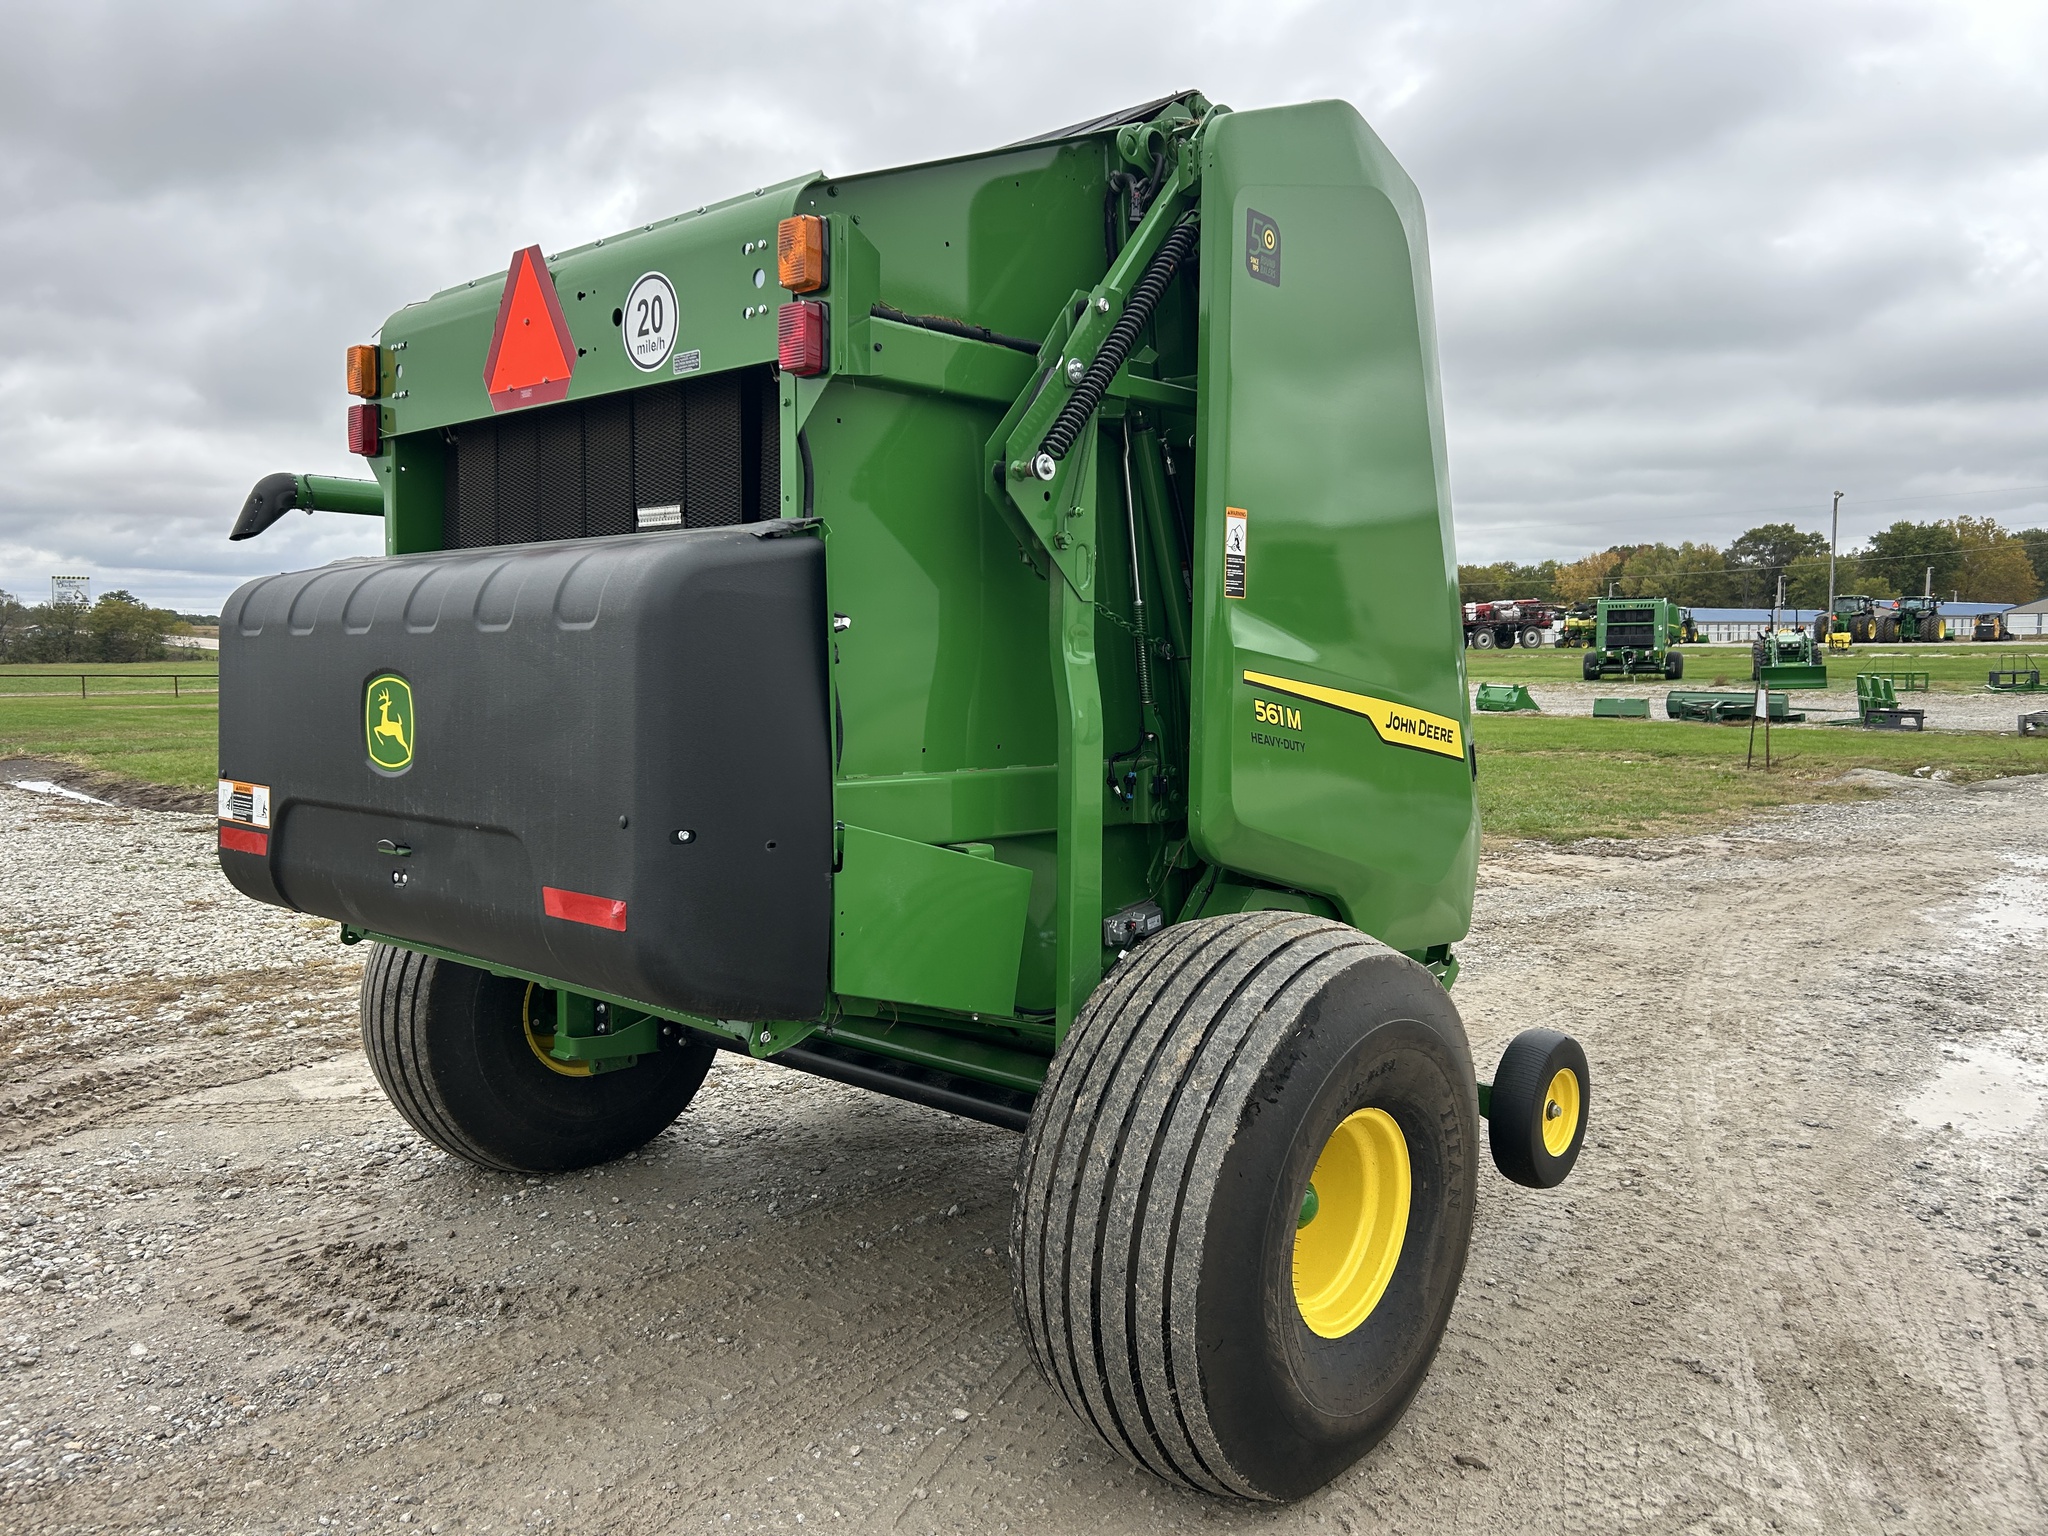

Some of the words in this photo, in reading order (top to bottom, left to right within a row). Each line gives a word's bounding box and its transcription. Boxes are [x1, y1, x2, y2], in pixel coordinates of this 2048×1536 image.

[1249, 217, 1278, 256] 50
[637, 294, 664, 338] 20
[636, 337, 666, 355] mile/h
[1250, 731, 1306, 753] HEAVY-DUTY
[1385, 711, 1417, 735] JOHN
[1418, 719, 1454, 744] DEERE
